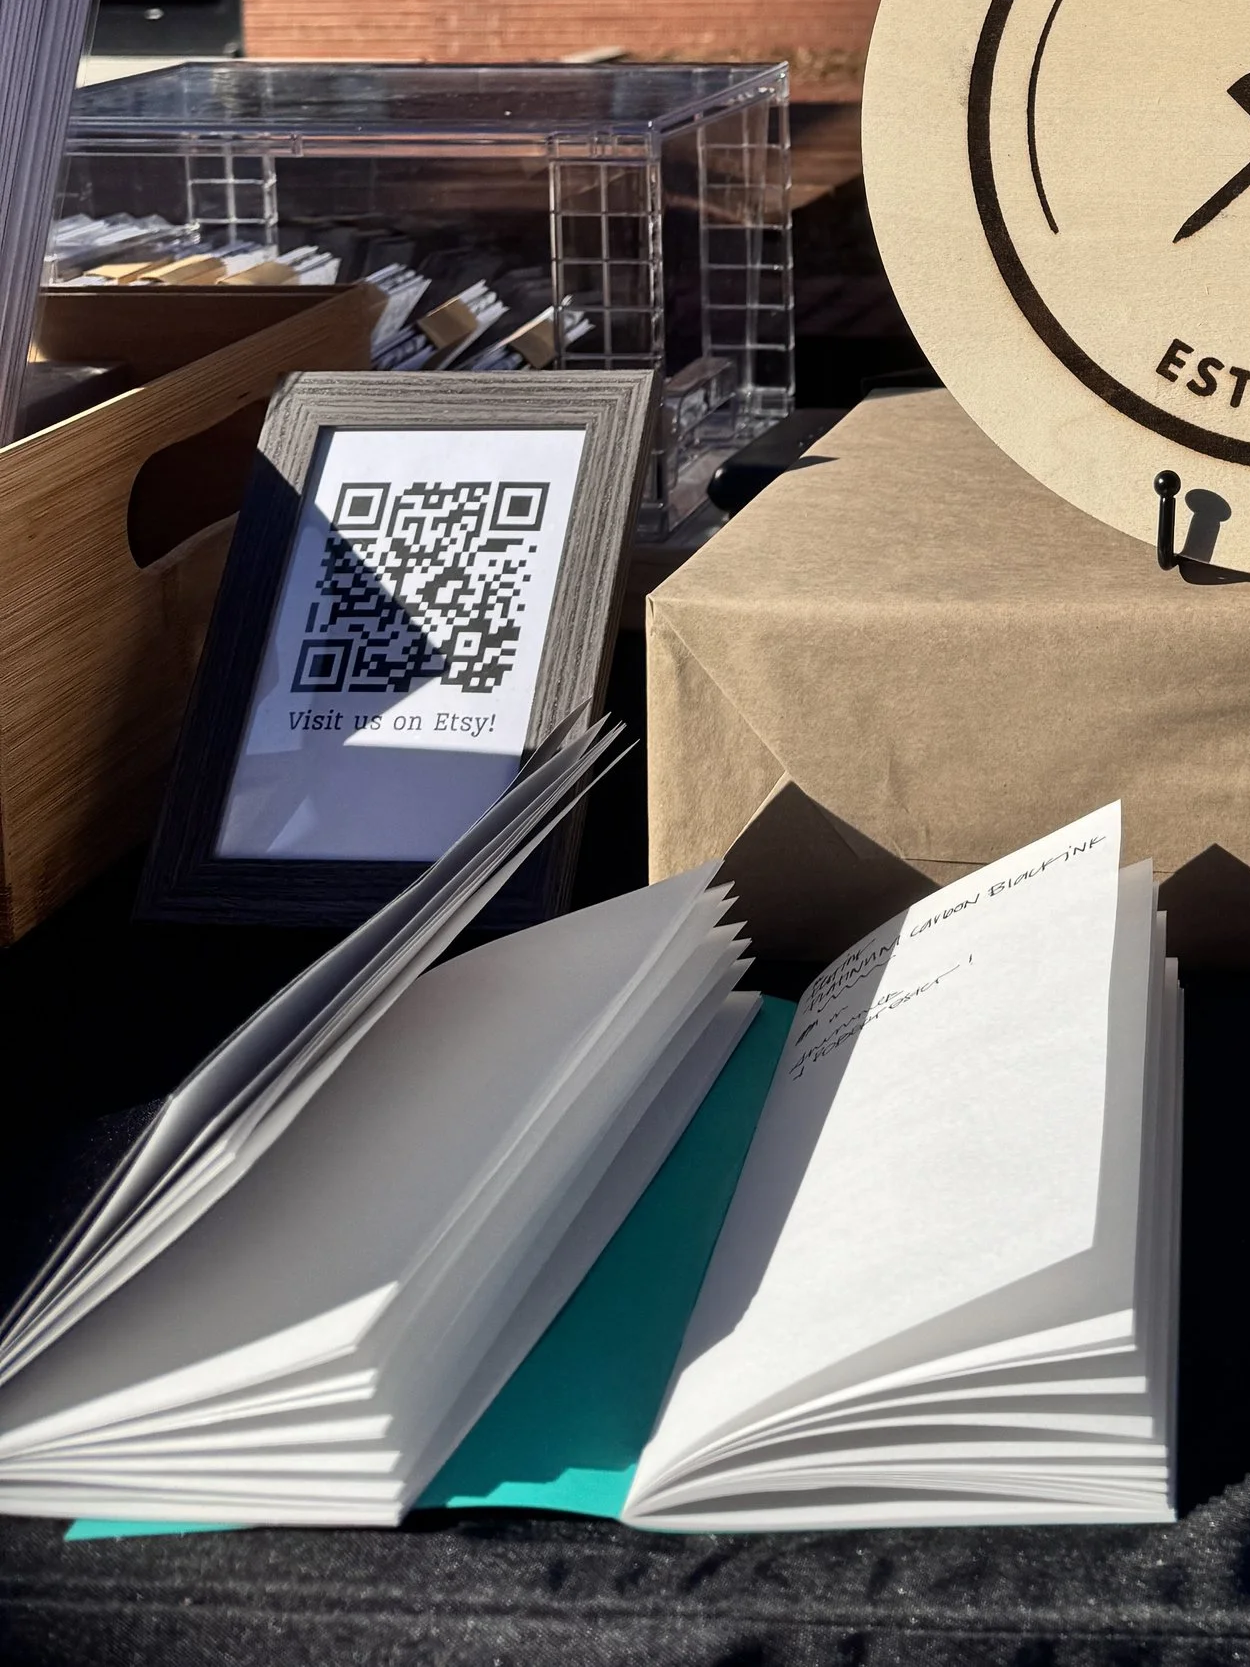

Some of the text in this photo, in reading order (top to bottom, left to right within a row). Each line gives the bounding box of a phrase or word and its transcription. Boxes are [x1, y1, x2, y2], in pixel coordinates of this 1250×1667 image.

[289, 709, 496, 737] Visit us on Etsy!
